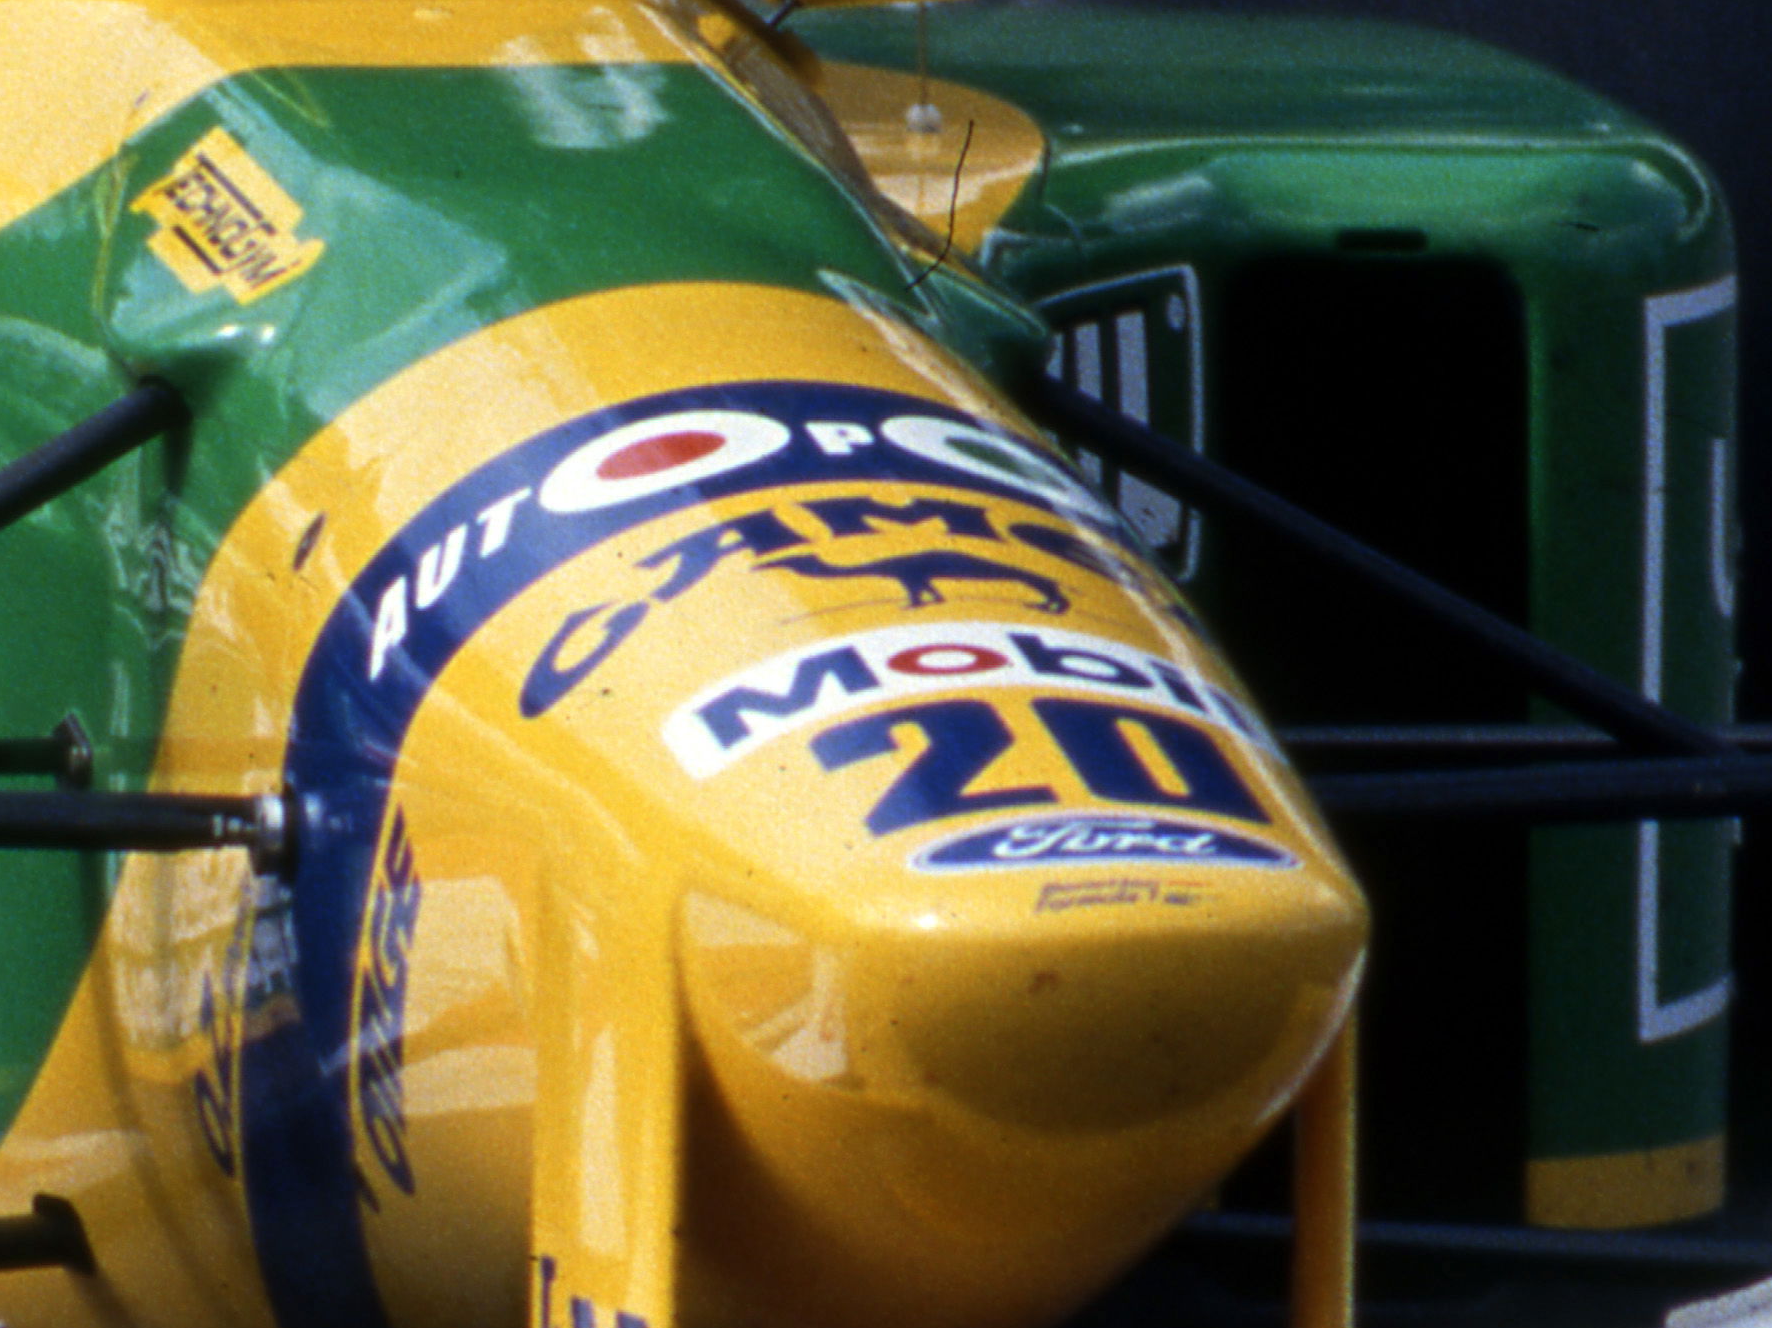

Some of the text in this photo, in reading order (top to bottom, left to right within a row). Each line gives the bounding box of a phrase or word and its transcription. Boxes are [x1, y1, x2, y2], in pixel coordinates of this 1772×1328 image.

[369, 409, 1120, 681] AUTOPO
[808, 697, 1280, 838] 20
[993, 821, 1217, 859] Ford
